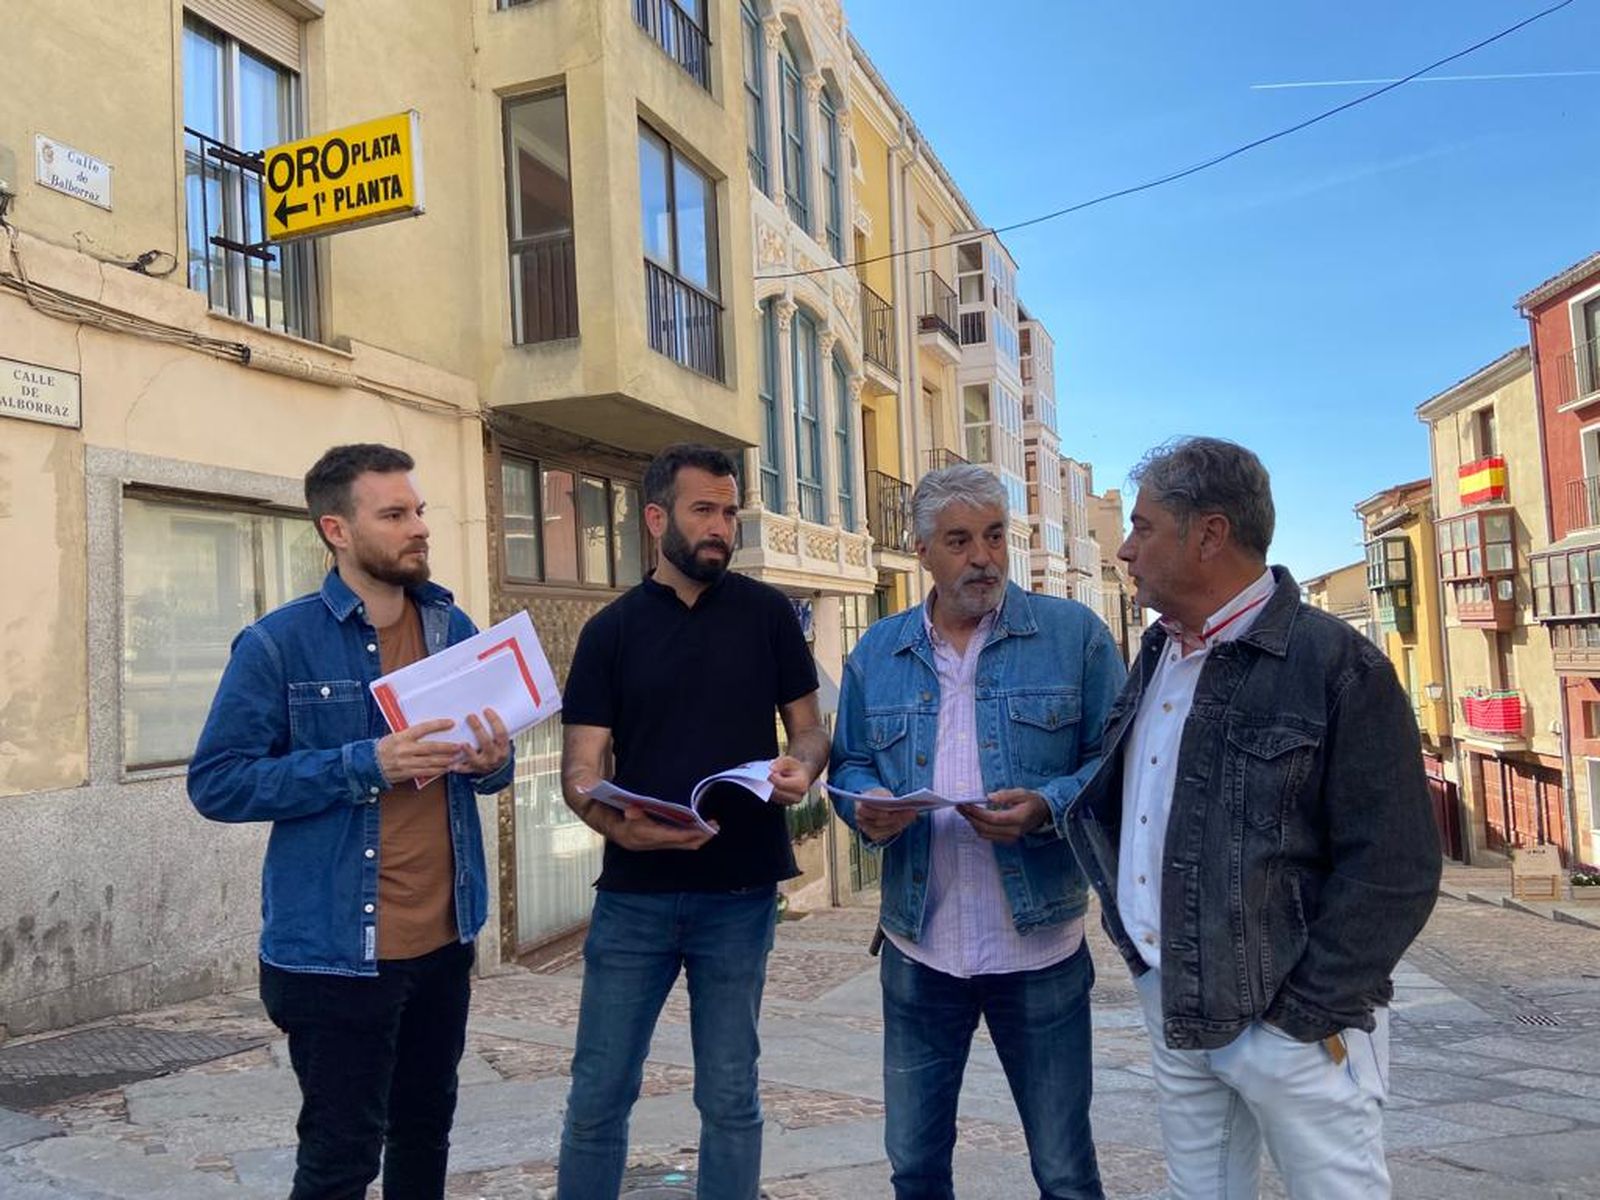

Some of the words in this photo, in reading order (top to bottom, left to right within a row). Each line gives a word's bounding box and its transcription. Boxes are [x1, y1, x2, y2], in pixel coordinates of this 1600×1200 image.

[67, 151, 99, 172] Calle
[267, 137, 350, 194] ORO
[351, 133, 401, 165] PLATA
[50, 174, 99, 201] Balborraz
[76, 171, 88, 184] de
[333, 174, 403, 212] PLANTA
[13, 370, 55, 386] CALLE
[21, 385, 39, 398] DE
[0, 396, 70, 417] ALBORRAZ
